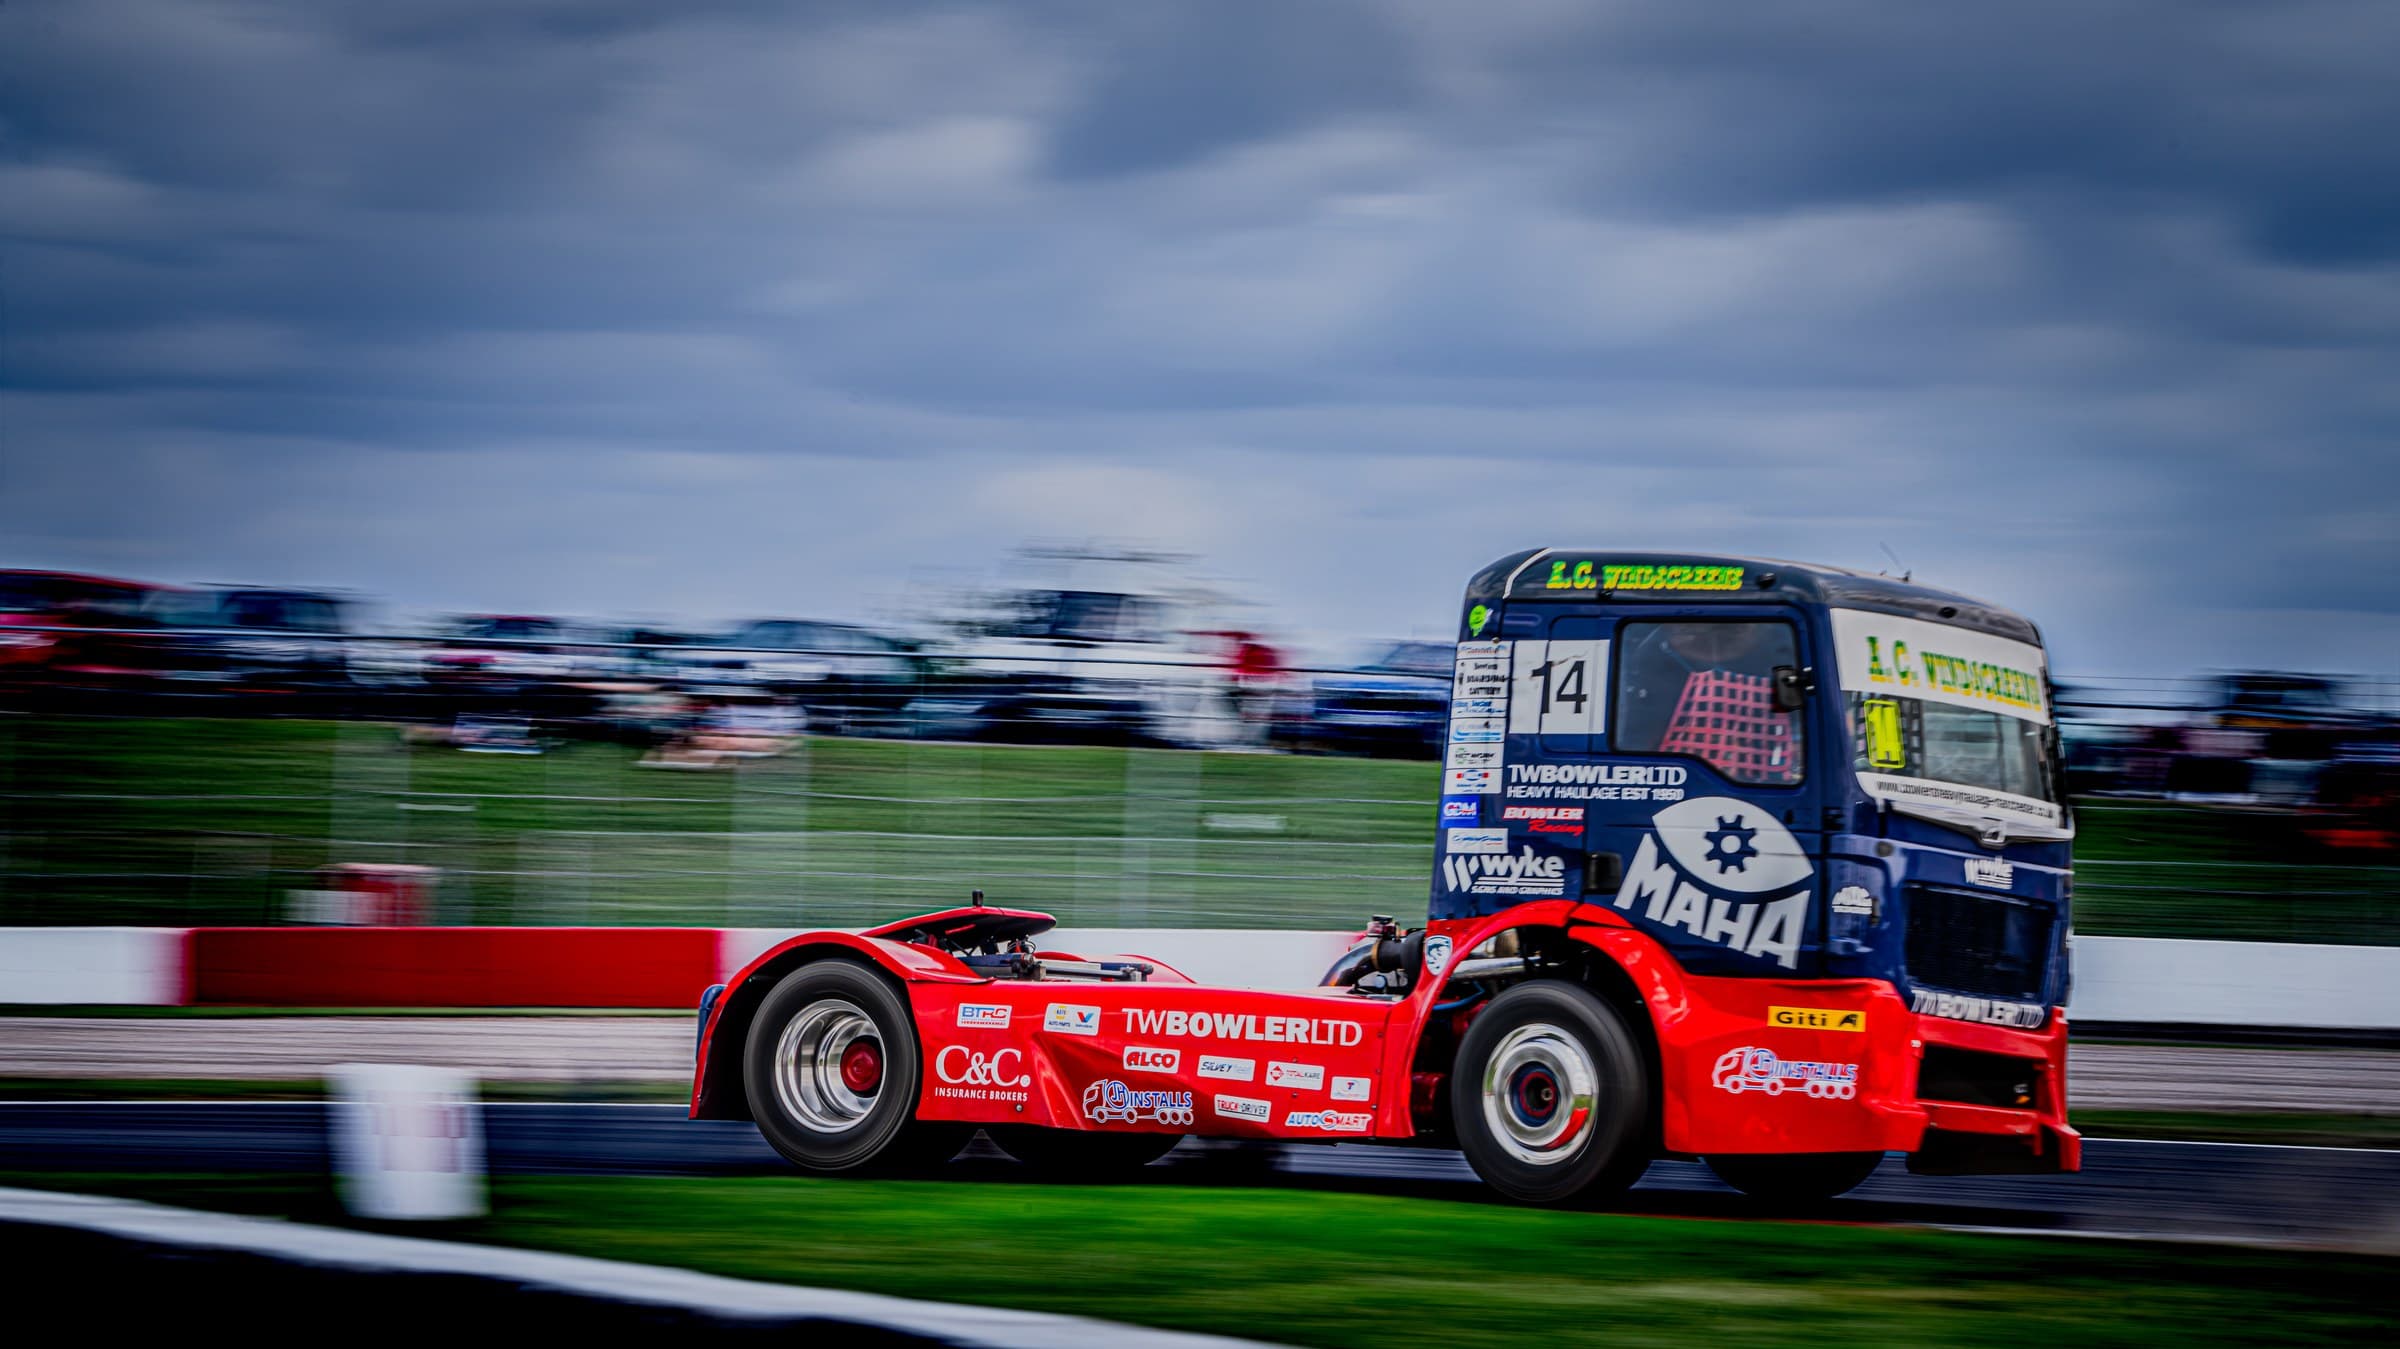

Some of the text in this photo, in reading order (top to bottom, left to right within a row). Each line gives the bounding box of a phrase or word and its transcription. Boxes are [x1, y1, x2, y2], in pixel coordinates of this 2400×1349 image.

[1601, 565, 1744, 590] WINDSCREENS
[1530, 660, 1588, 715] 14
[1507, 786, 1554, 798] HEAVY
[1554, 787, 1621, 800] HAULAGE
[1621, 787, 1650, 800] EST
[1503, 806, 1585, 820] BOWLER
[1528, 819, 1584, 837] Racing
[1613, 833, 1811, 970] MAHA
[962, 1006, 1007, 1019] BTRC
[1777, 1011, 1828, 1026] Giti
[1122, 1008, 1363, 1046] TWBOWLERLTD
[1126, 1051, 1176, 1069] ALCO
[1775, 1060, 1860, 1081] INSTALLS
[935, 1087, 1028, 1102] INSURANCE BROKERS
[1129, 1091, 1193, 1108] INSTALLS
